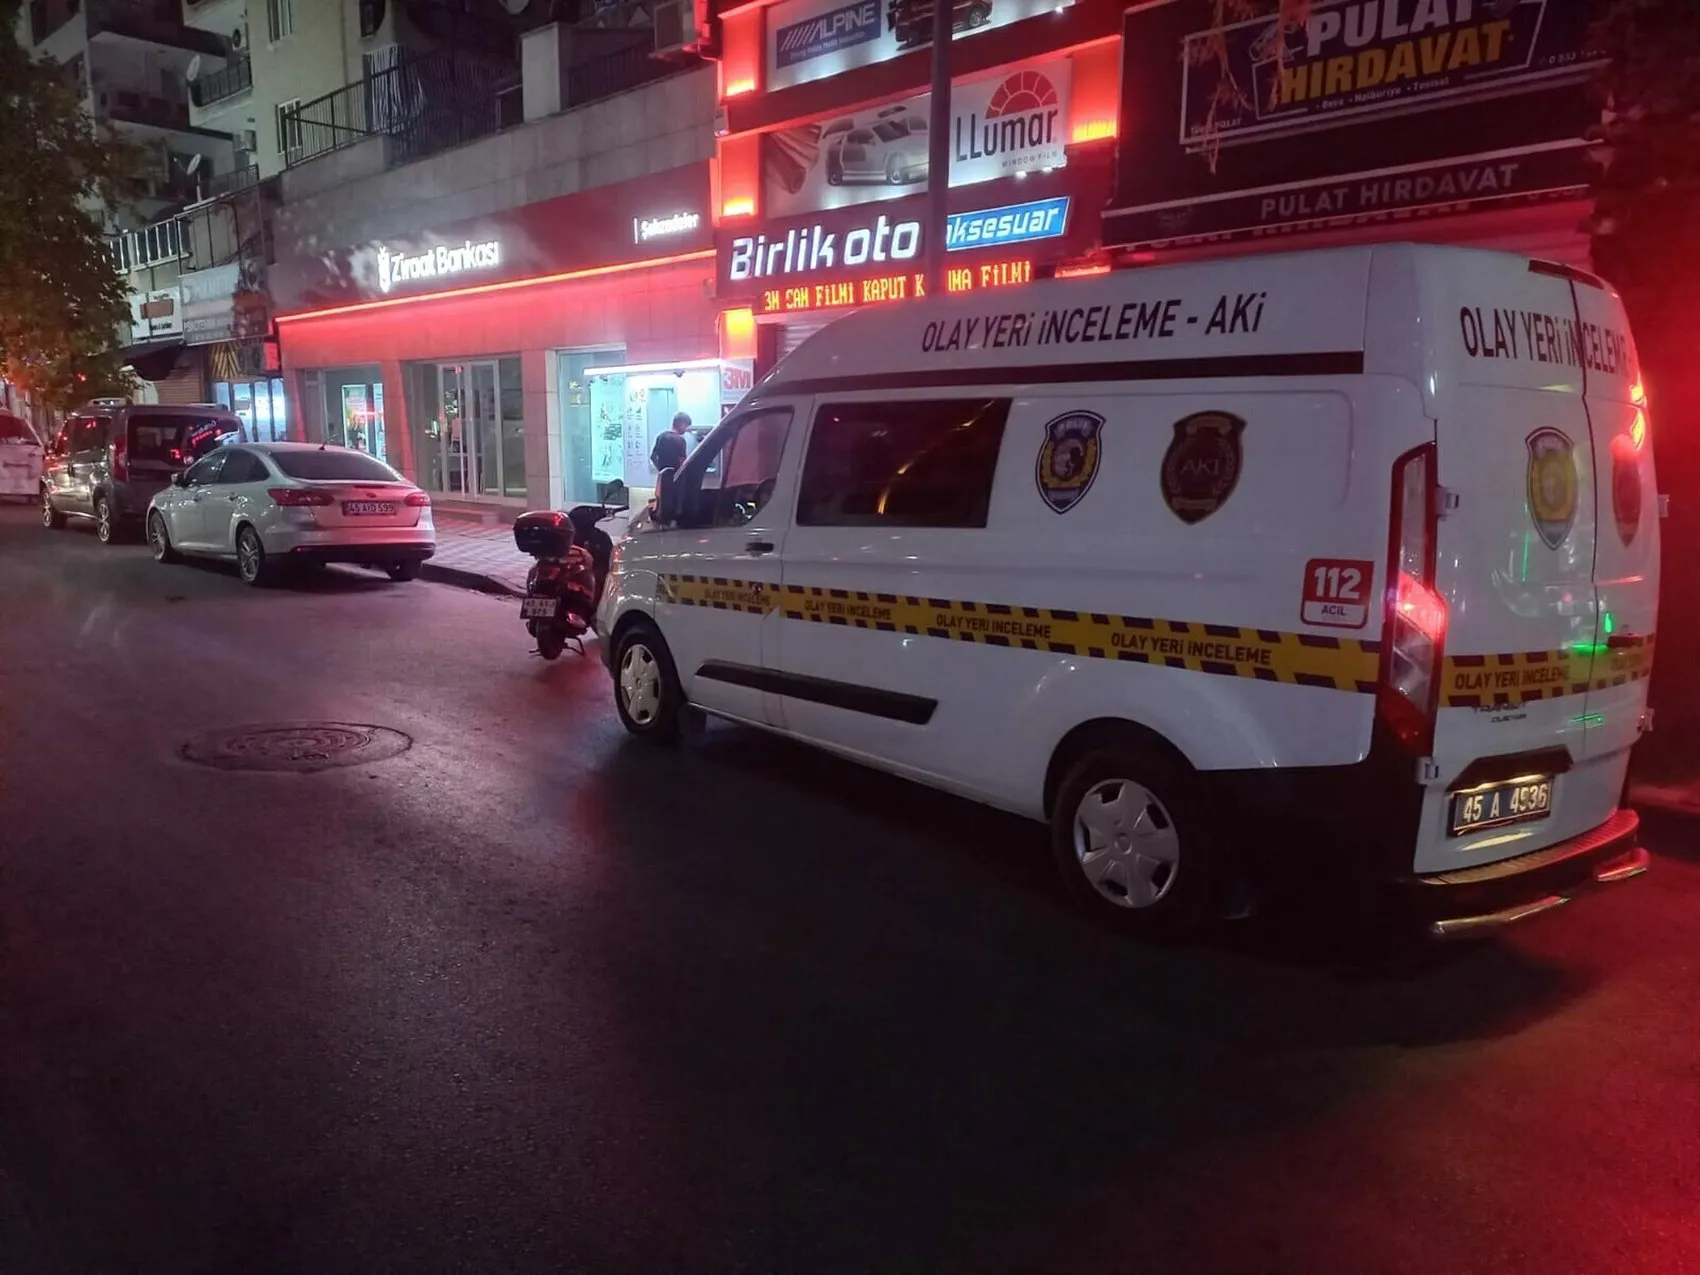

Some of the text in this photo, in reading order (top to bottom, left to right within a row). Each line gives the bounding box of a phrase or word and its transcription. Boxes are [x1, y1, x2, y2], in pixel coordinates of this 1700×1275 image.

[809, 3, 876, 43] ALPINE
[1280, 19, 1512, 105] HIRDAVAT
[955, 108, 1058, 162] LLumar
[1002, 154, 1036, 168] WINDOW
[1261, 188, 1348, 220] PULAT
[1359, 164, 1519, 206] HIRDAVAT
[730, 225, 835, 280] Birlik
[843, 215, 920, 265] oto
[391, 249, 436, 282] Ziraat
[764, 290, 780, 311] 3M
[862, 276, 907, 302] KAPUT
[922, 318, 981, 353] OLAY
[1460, 306, 1517, 360] OLAY
[724, 367, 752, 389] 3M
[1314, 566, 1361, 600] 112
[804, 599, 825, 613] OLAY
[936, 613, 963, 629] OLAY
[1111, 632, 1149, 651] OLAY
[1455, 672, 1492, 690] OLAY
[1463, 783, 1548, 822] 45 A 4936
